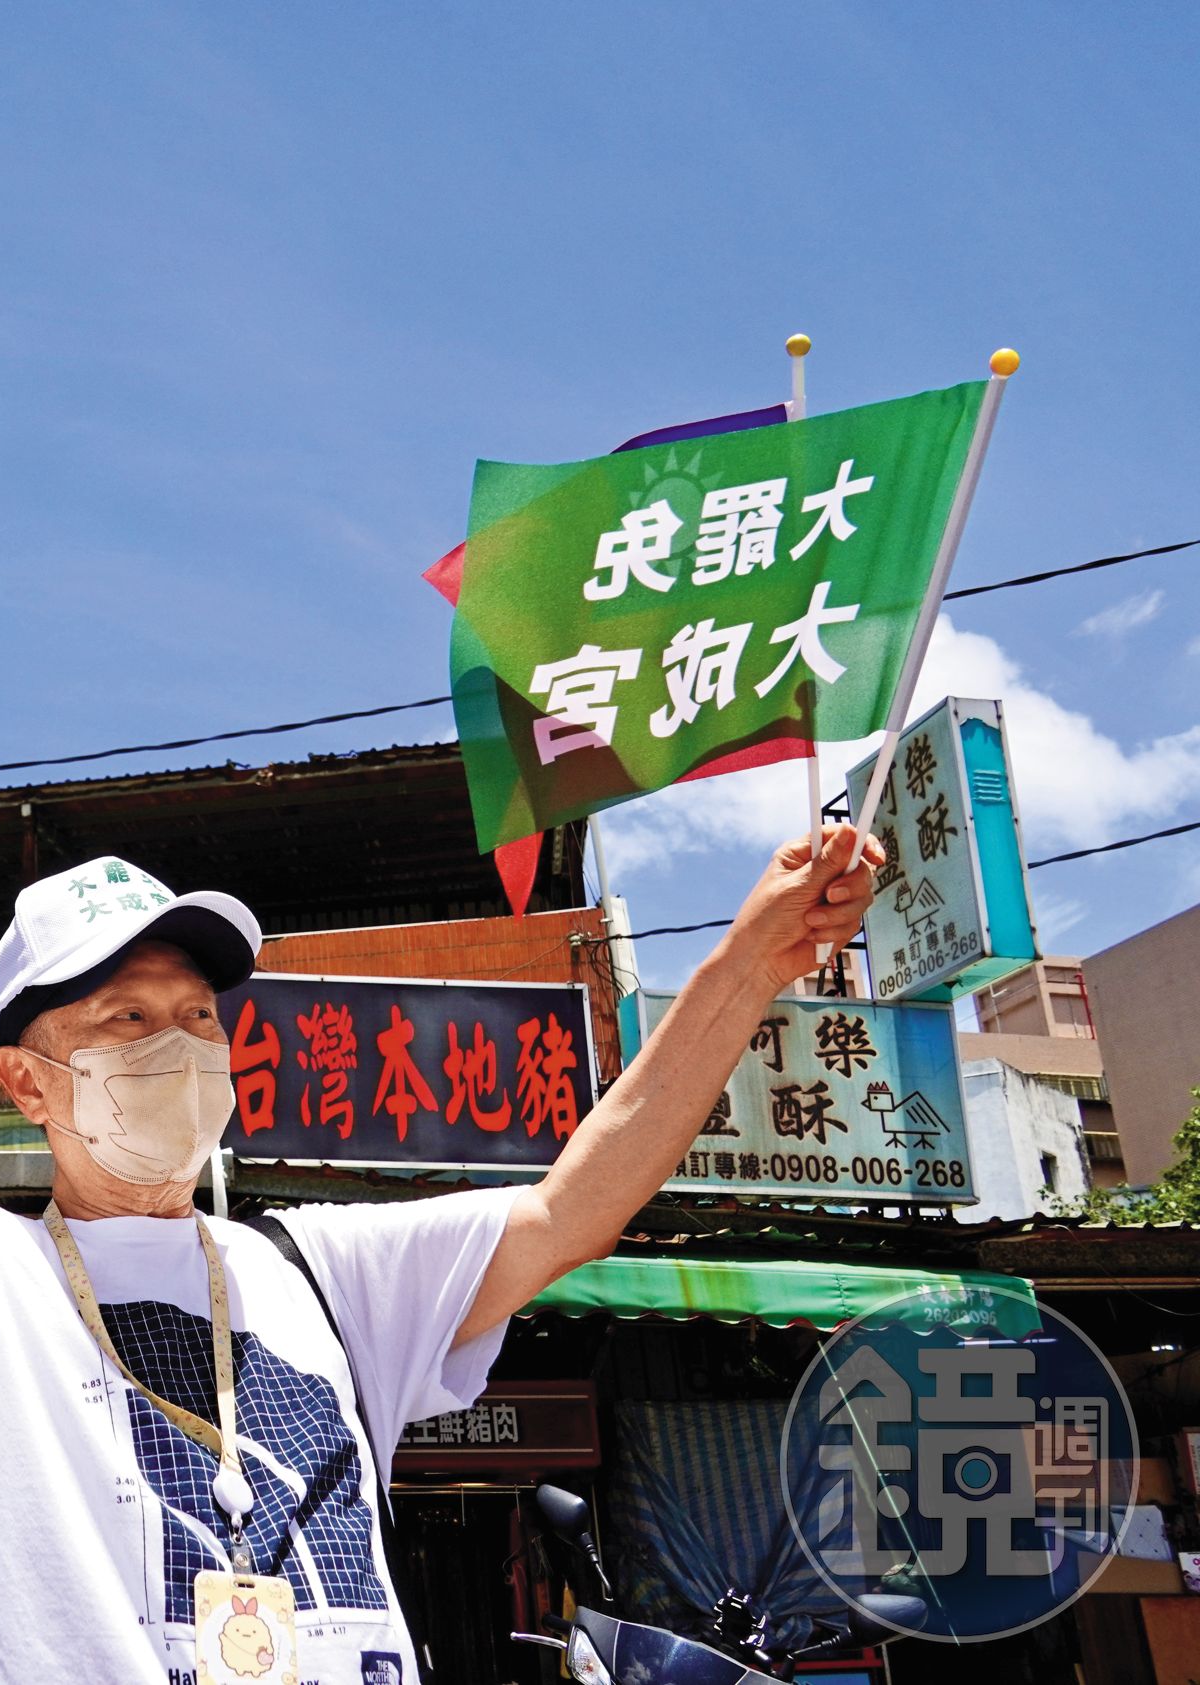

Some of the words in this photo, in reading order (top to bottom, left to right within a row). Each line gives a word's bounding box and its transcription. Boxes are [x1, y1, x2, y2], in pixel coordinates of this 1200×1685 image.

[879, 931, 978, 998] 0908-006-268
[893, 921, 957, 971] 預訂專線
[230, 999, 578, 1142] 台灣本地豬
[399, 1403, 519, 1444] 鮮豬肉
[116, 1494, 137, 1504] 3.01
[376, 1660, 388, 1671] THE
